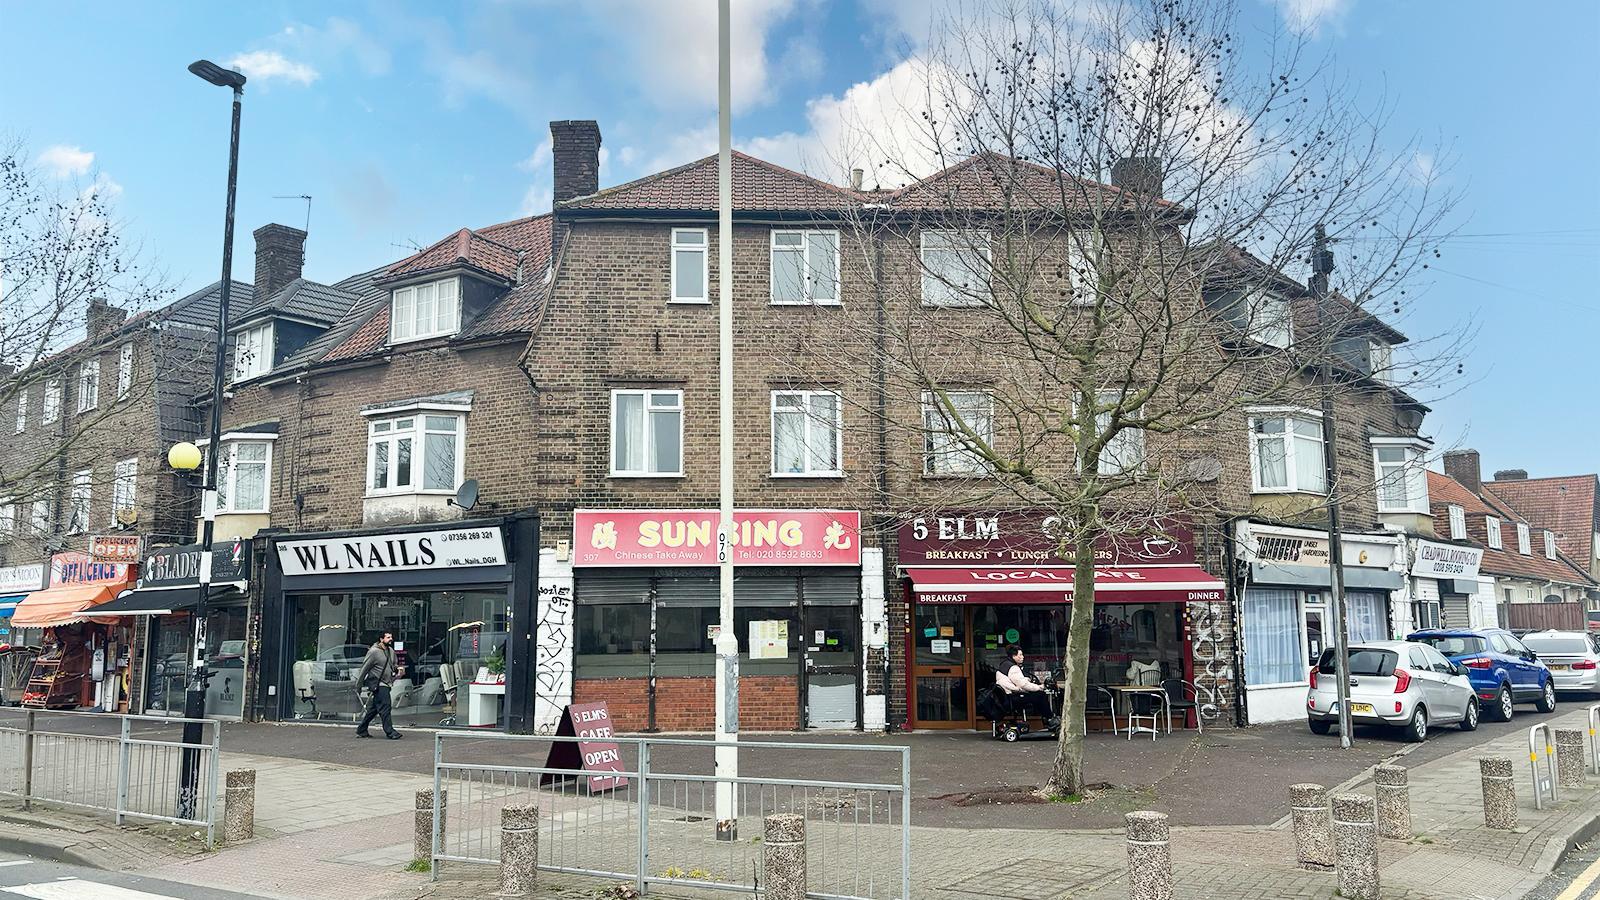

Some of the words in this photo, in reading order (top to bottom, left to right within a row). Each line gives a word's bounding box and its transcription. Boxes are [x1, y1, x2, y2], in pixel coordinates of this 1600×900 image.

[638, 520, 711, 547] SUN
[823, 520, 852, 550] 光
[913, 518, 928, 540] 5
[95, 544, 138, 557] OPEN
[293, 544, 339, 571] WL
[343, 537, 436, 567] NAILS
[583, 553, 599, 561] 307
[615, 550, 653, 560] Chinese
[655, 550, 676, 560] Take
[678, 550, 703, 562] Away
[738, 550, 755, 559] Tel:
[756, 551, 774, 559] 020
[775, 551, 798, 559] 8592
[800, 550, 823, 559] 8633
[925, 551, 990, 560] BREAKFAST
[1011, 551, 1049, 560] LUNCH
[61, 563, 79, 584] OFF
[79, 559, 116, 582] LICENCE
[970, 571, 1068, 581] LOCAL
[1071, 571, 1147, 581] AFE
[920, 594, 968, 602] BREAKFAST
[1188, 591, 1221, 600] DINNER
[581, 708, 608, 722] ELM'S
[585, 748, 620, 766] OPEN
